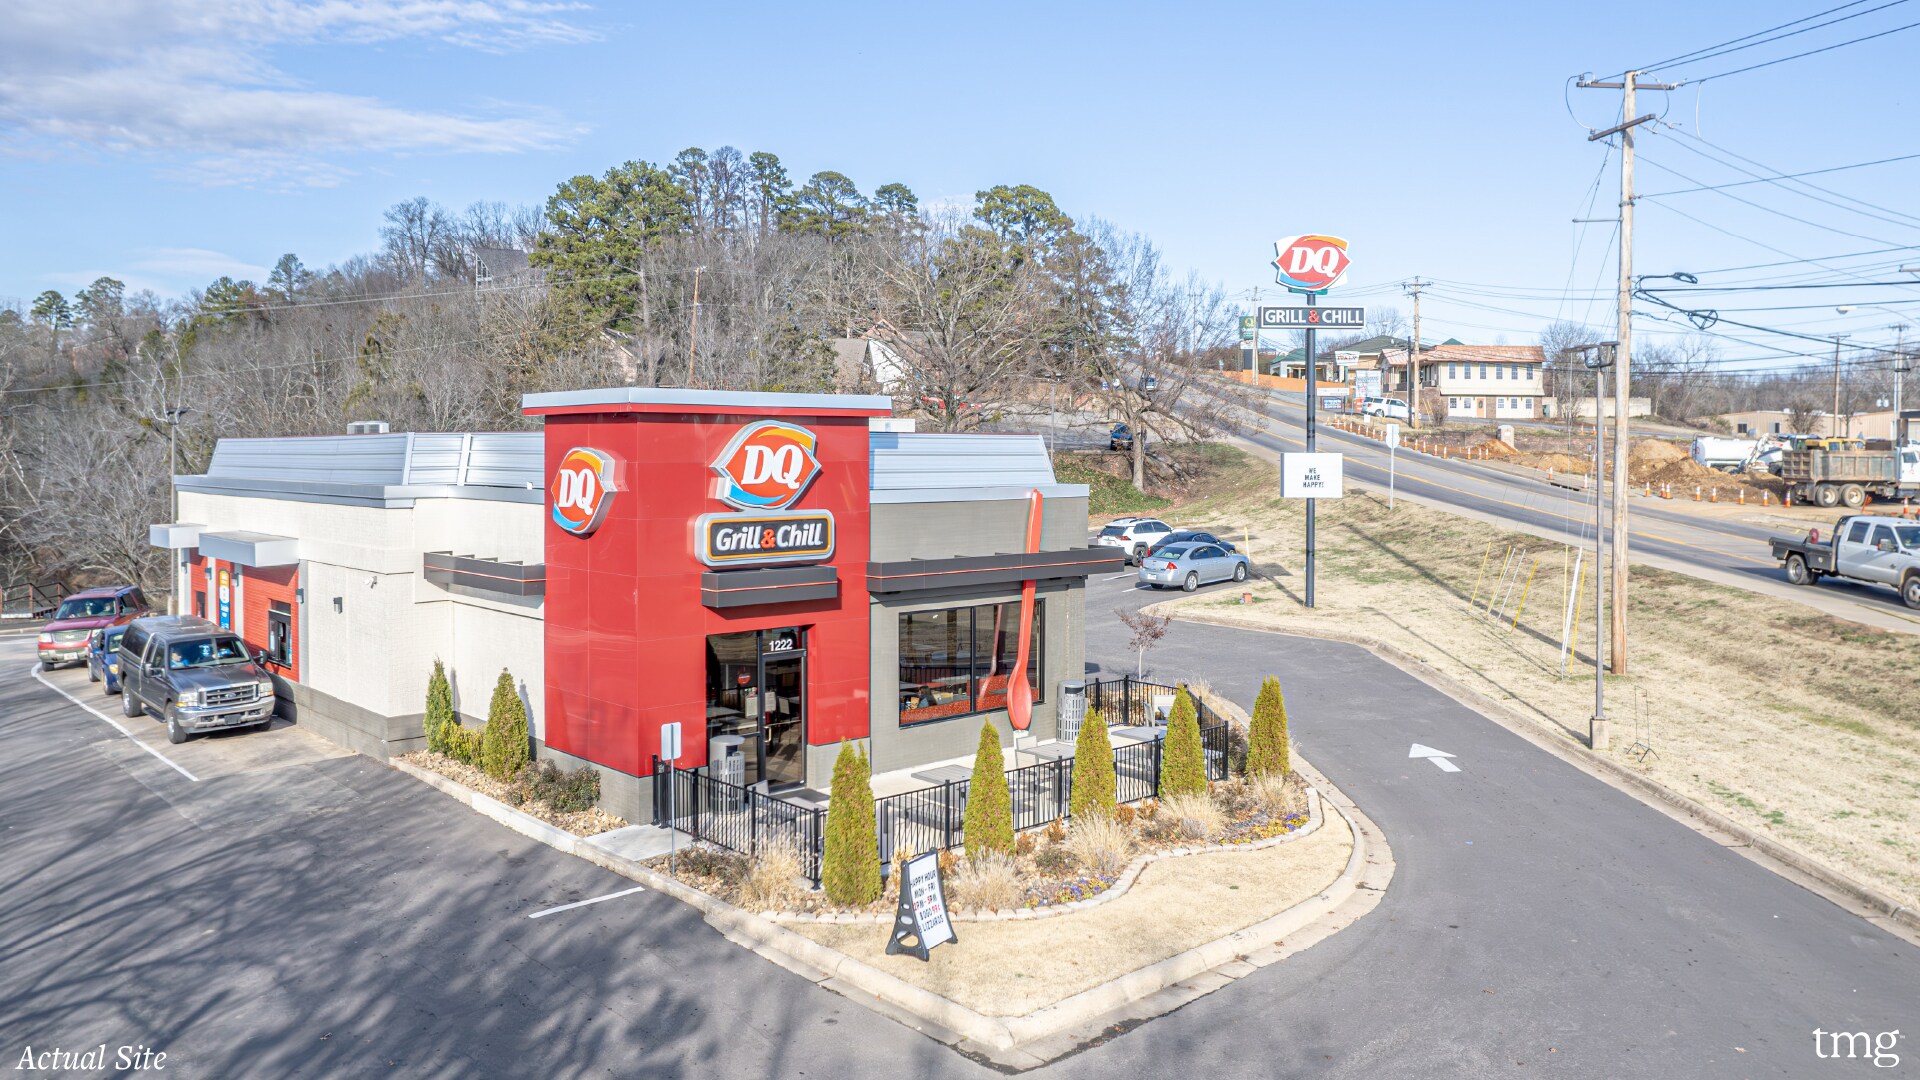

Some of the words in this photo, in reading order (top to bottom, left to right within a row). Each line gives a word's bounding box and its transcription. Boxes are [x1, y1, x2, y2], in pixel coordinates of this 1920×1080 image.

[1288, 246, 1337, 278] DQ
[1265, 309, 1307, 323] GRILL
[1308, 309, 1319, 324] &
[1321, 309, 1363, 324] CHILL
[740, 444, 804, 490] DQ
[558, 468, 596, 516] DQ
[768, 639, 793, 652] 1222
[925, 869, 936, 881] HOUR
[914, 887, 924, 899] MON
